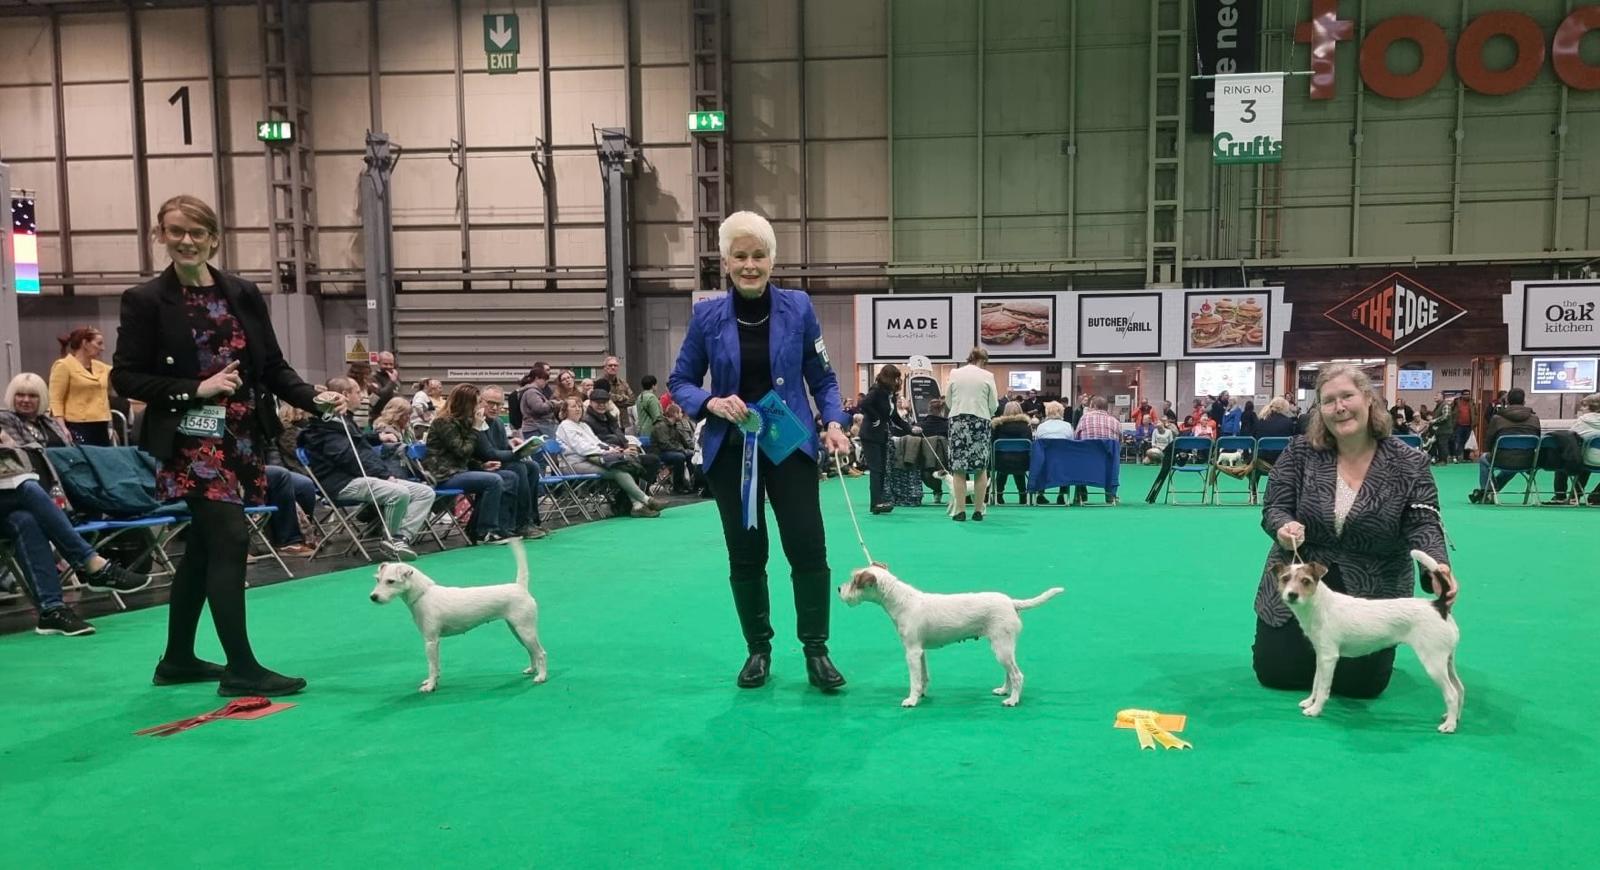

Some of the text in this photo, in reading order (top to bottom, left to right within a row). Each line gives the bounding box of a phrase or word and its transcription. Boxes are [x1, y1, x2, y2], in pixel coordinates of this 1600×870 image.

[490, 53, 514, 69] EXIT
[1223, 84, 1274, 95] RING NO.
[168, 86, 192, 146] 1
[1239, 99, 1257, 124] 3
[1213, 131, 1283, 157] Crufts
[1562, 299, 1578, 307] the
[1394, 283, 1439, 341] EDGE
[1545, 301, 1595, 322] Oak
[886, 318, 939, 330] MADE
[1088, 317, 1128, 328] BUTCHER
[1127, 321, 1153, 332] GRILL
[1544, 322, 1593, 333] kitchen
[917, 358, 923, 367] 3
[1441, 367, 1461, 377] WHAT
